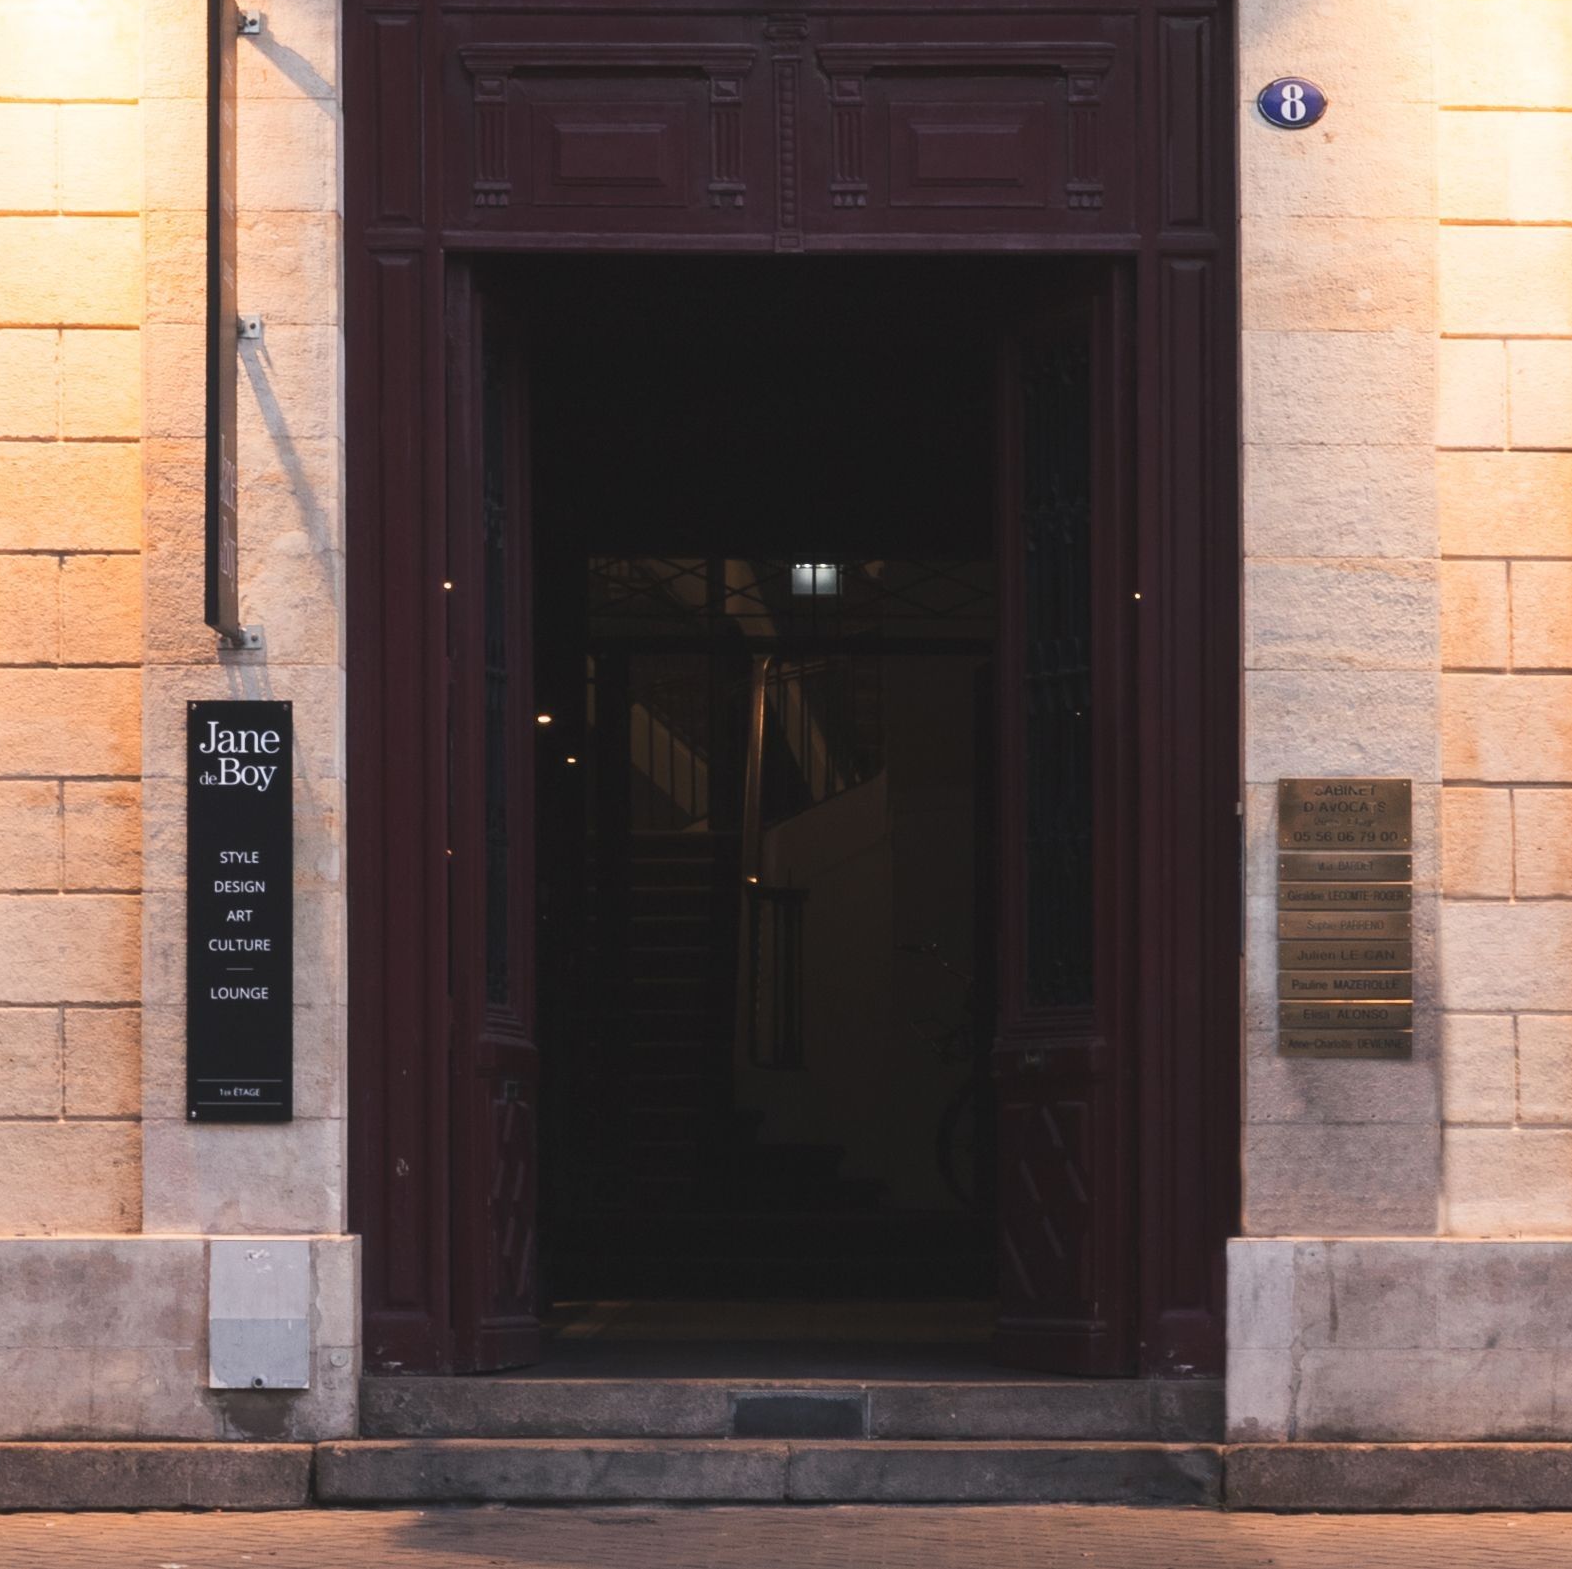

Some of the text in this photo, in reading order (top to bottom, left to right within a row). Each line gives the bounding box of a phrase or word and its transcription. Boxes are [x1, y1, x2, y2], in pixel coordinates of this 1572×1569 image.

[1280, 83, 1306, 121] 8
[199, 721, 280, 753] Jane
[199, 757, 277, 792] de Boy
[1293, 832, 1311, 842] 05
[1380, 832, 1398, 842] 00
[219, 851, 259, 864] STYLE
[214, 880, 266, 893] DESIGN
[226, 909, 253, 922] ART
[208, 938, 271, 952] CULTURE
[1340, 950, 1358, 961] LE
[1291, 979, 1329, 990] Pauline
[210, 987, 269, 1000] LOUNGE
[1336, 1008, 1389, 1020] ALONSO
